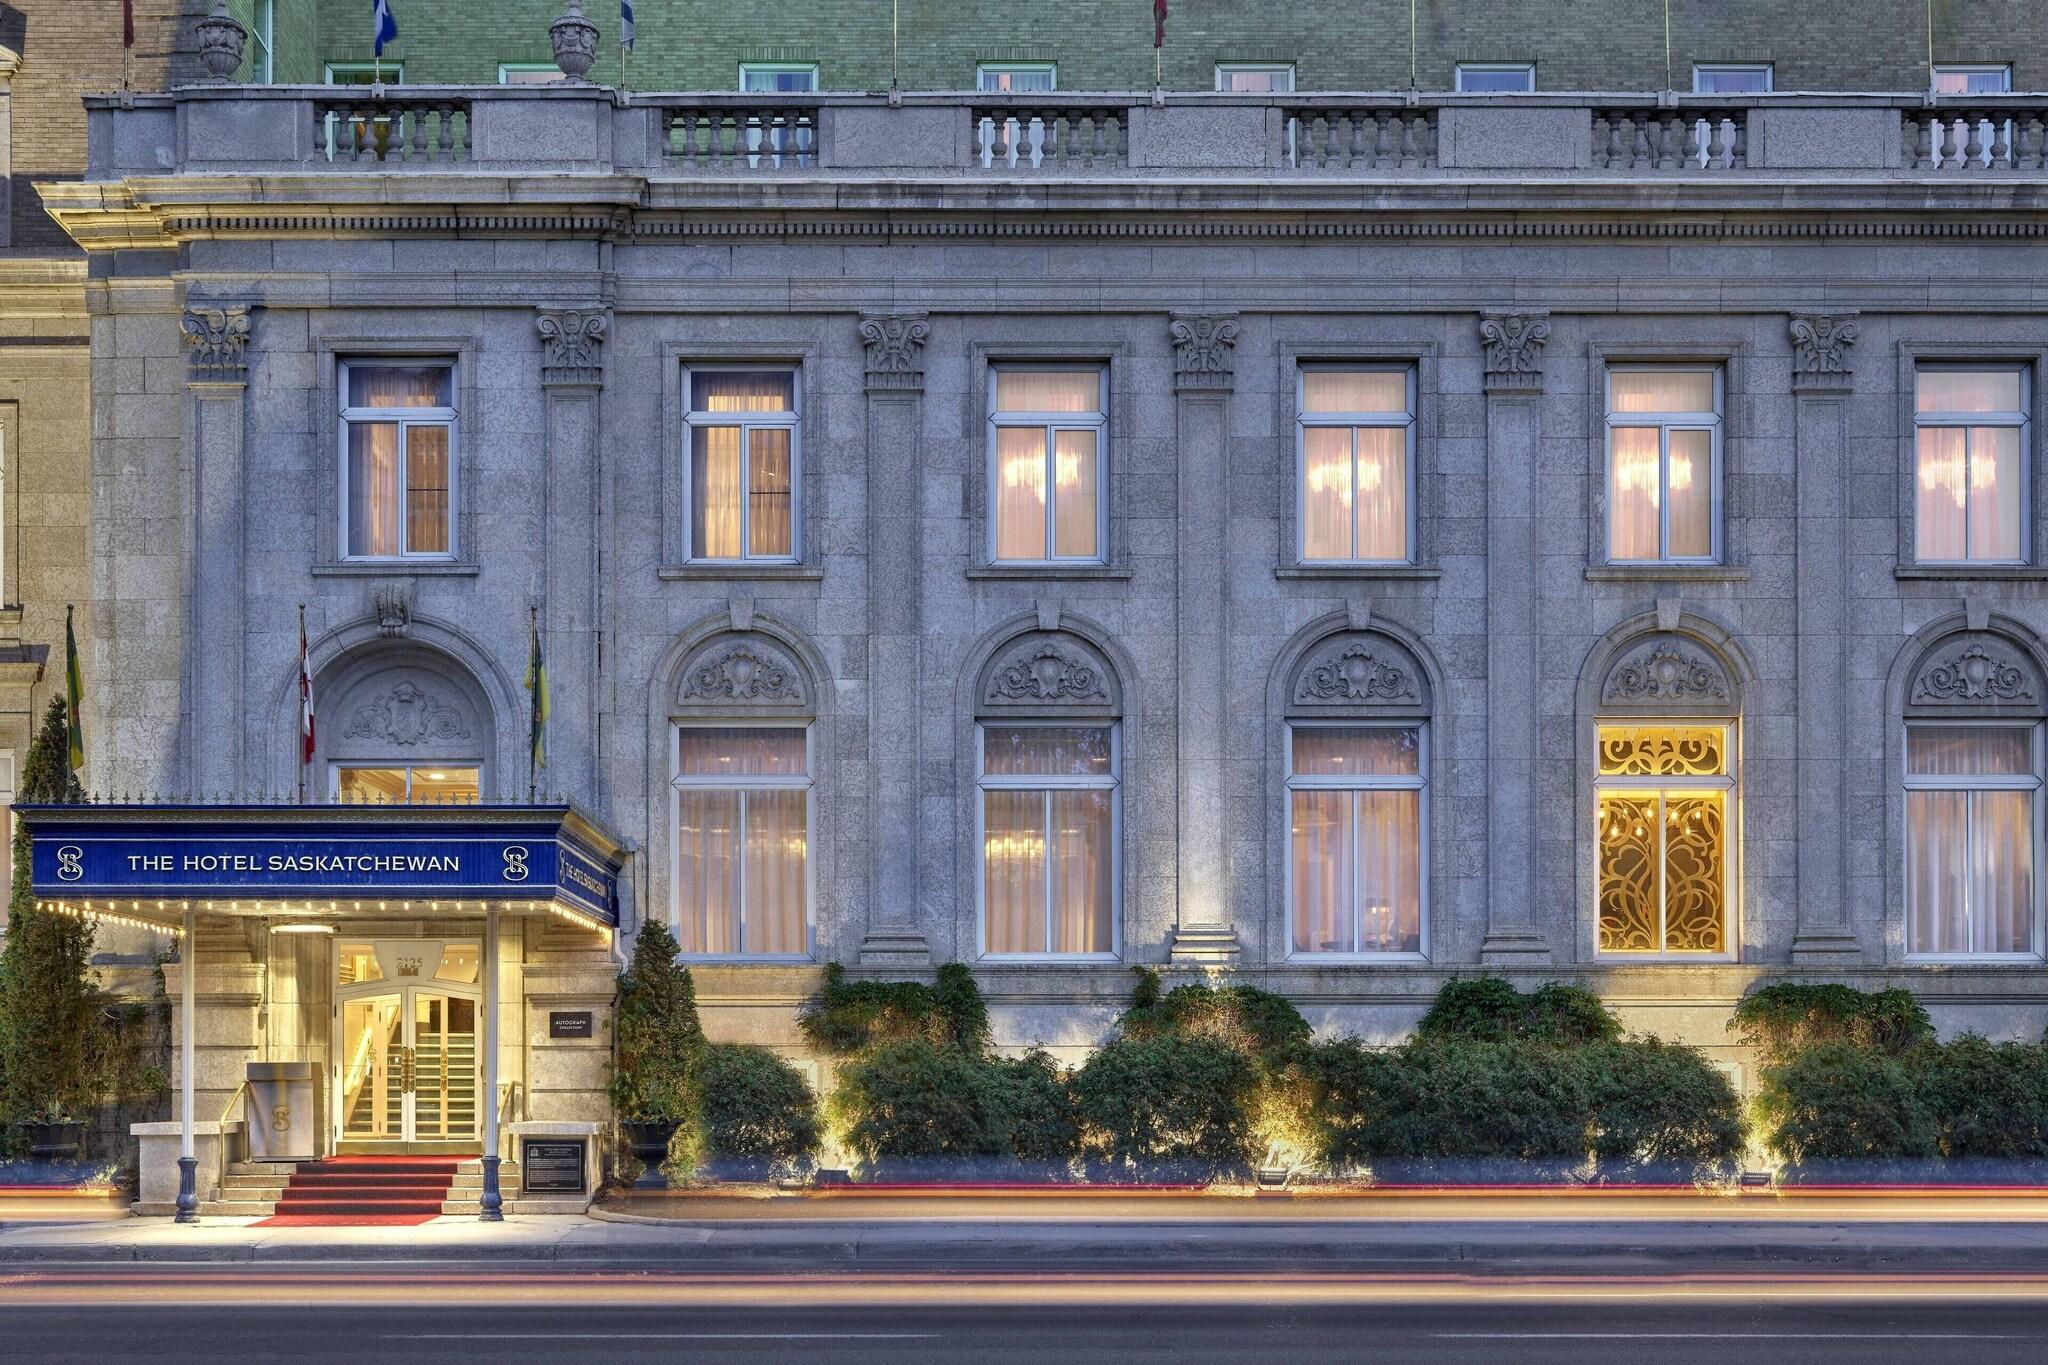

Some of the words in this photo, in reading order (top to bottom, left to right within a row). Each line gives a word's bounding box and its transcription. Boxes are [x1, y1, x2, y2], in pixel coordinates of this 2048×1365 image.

[127, 855, 175, 871] THE
[183, 855, 263, 871] HOTEL
[268, 855, 460, 871] SASKATCHEWAN
